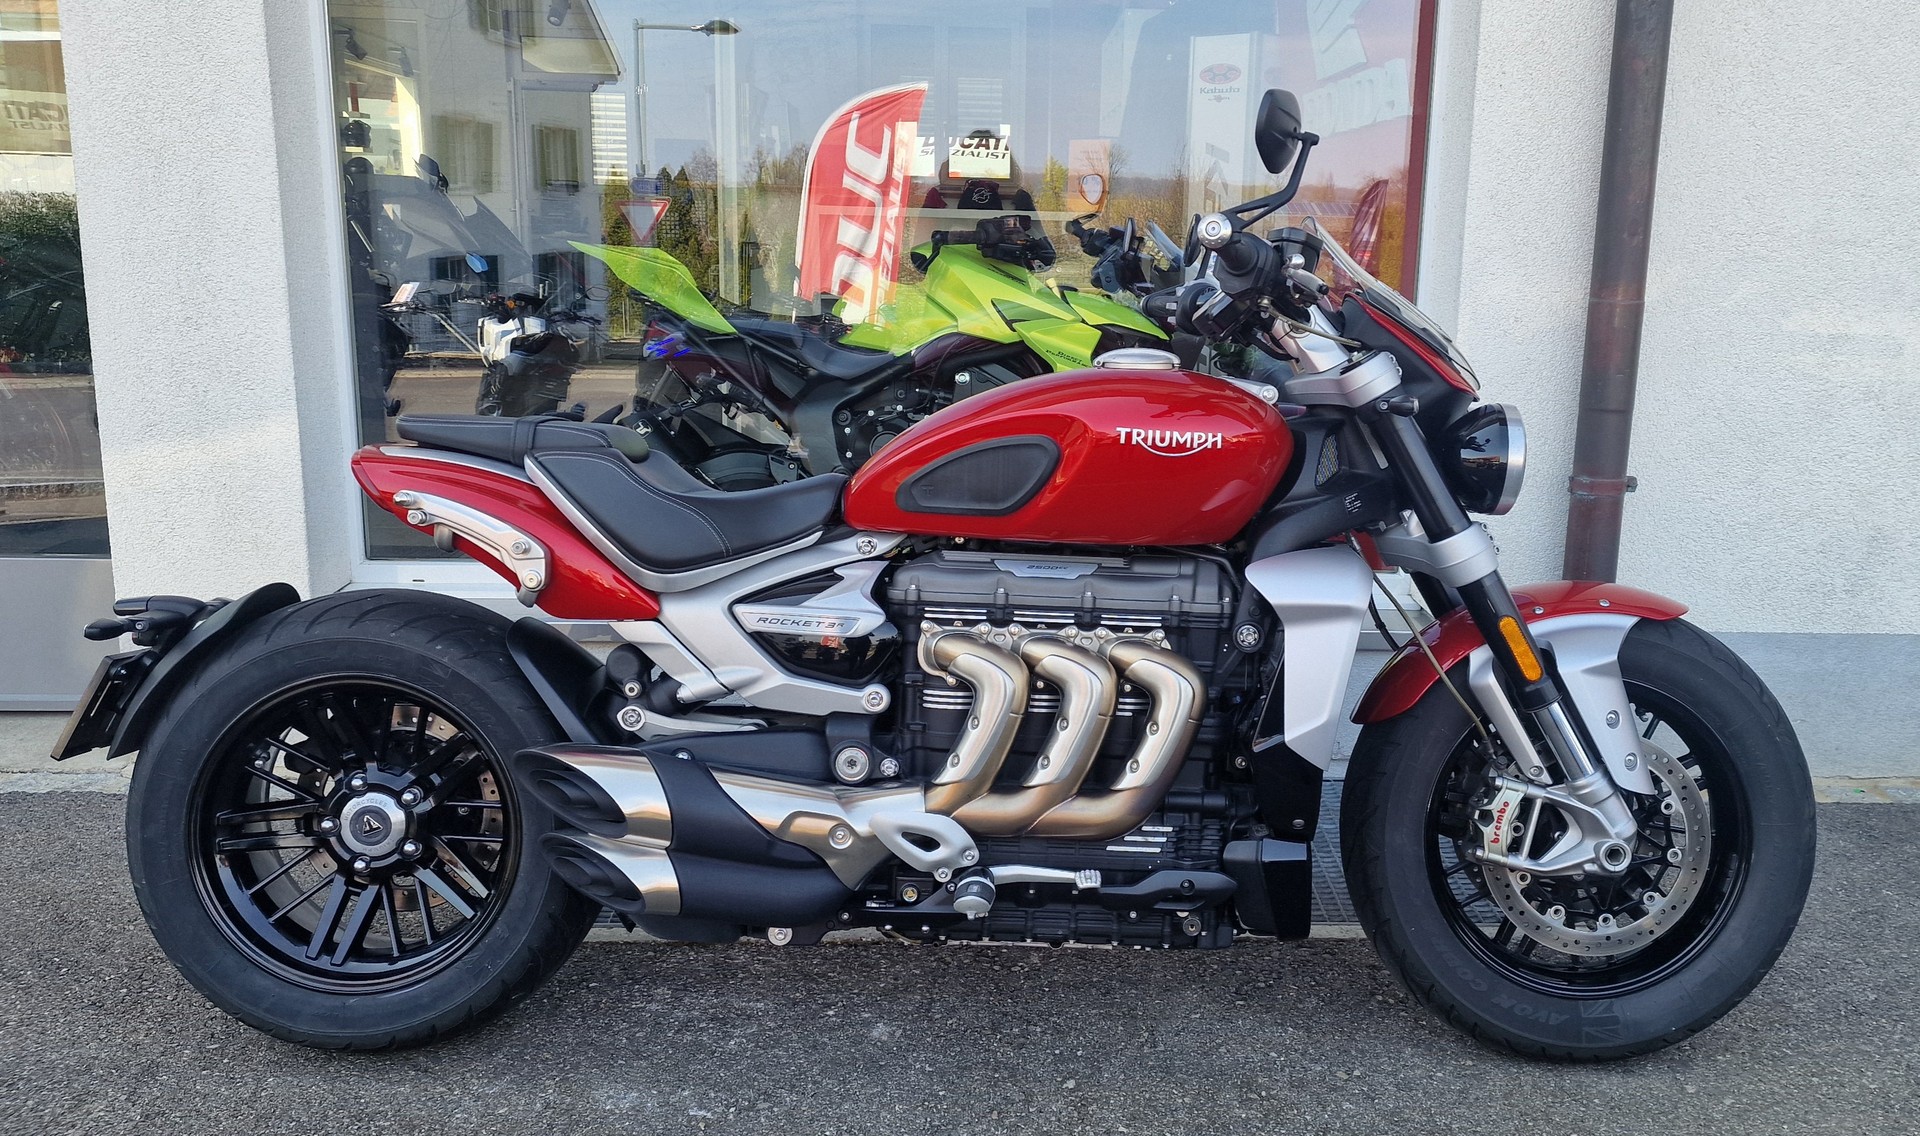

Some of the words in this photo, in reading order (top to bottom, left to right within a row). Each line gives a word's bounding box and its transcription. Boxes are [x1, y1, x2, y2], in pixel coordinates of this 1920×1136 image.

[1200, 85, 1240, 94] Kabuto
[1116, 427, 1222, 456] TRIUMPH
[756, 617, 825, 628] ROCKET
[1490, 801, 1509, 844] brembo
[1490, 995, 1570, 1025] AVON
